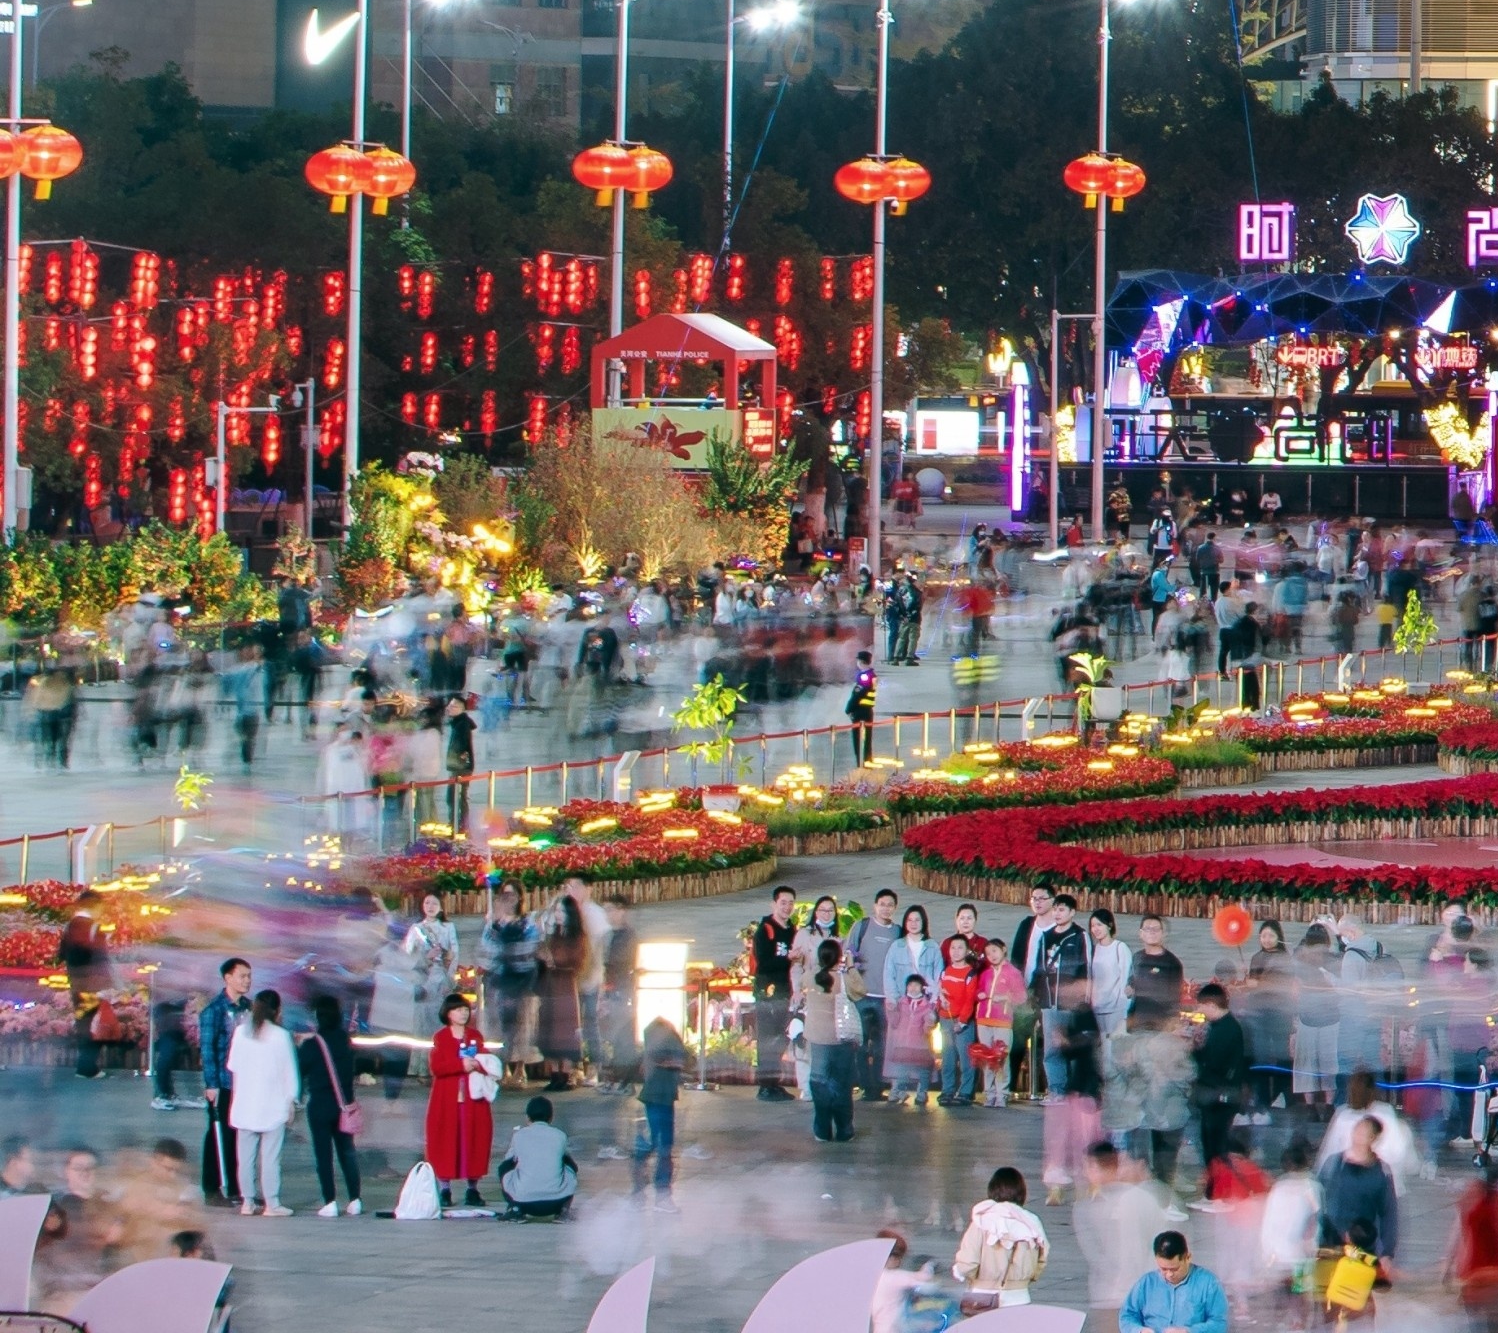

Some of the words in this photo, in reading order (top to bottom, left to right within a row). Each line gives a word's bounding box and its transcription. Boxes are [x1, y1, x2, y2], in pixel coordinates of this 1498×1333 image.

[1239, 201, 1295, 261] 时
[683, 350, 709, 359] POLICE
[1307, 347, 1338, 365] BRT
